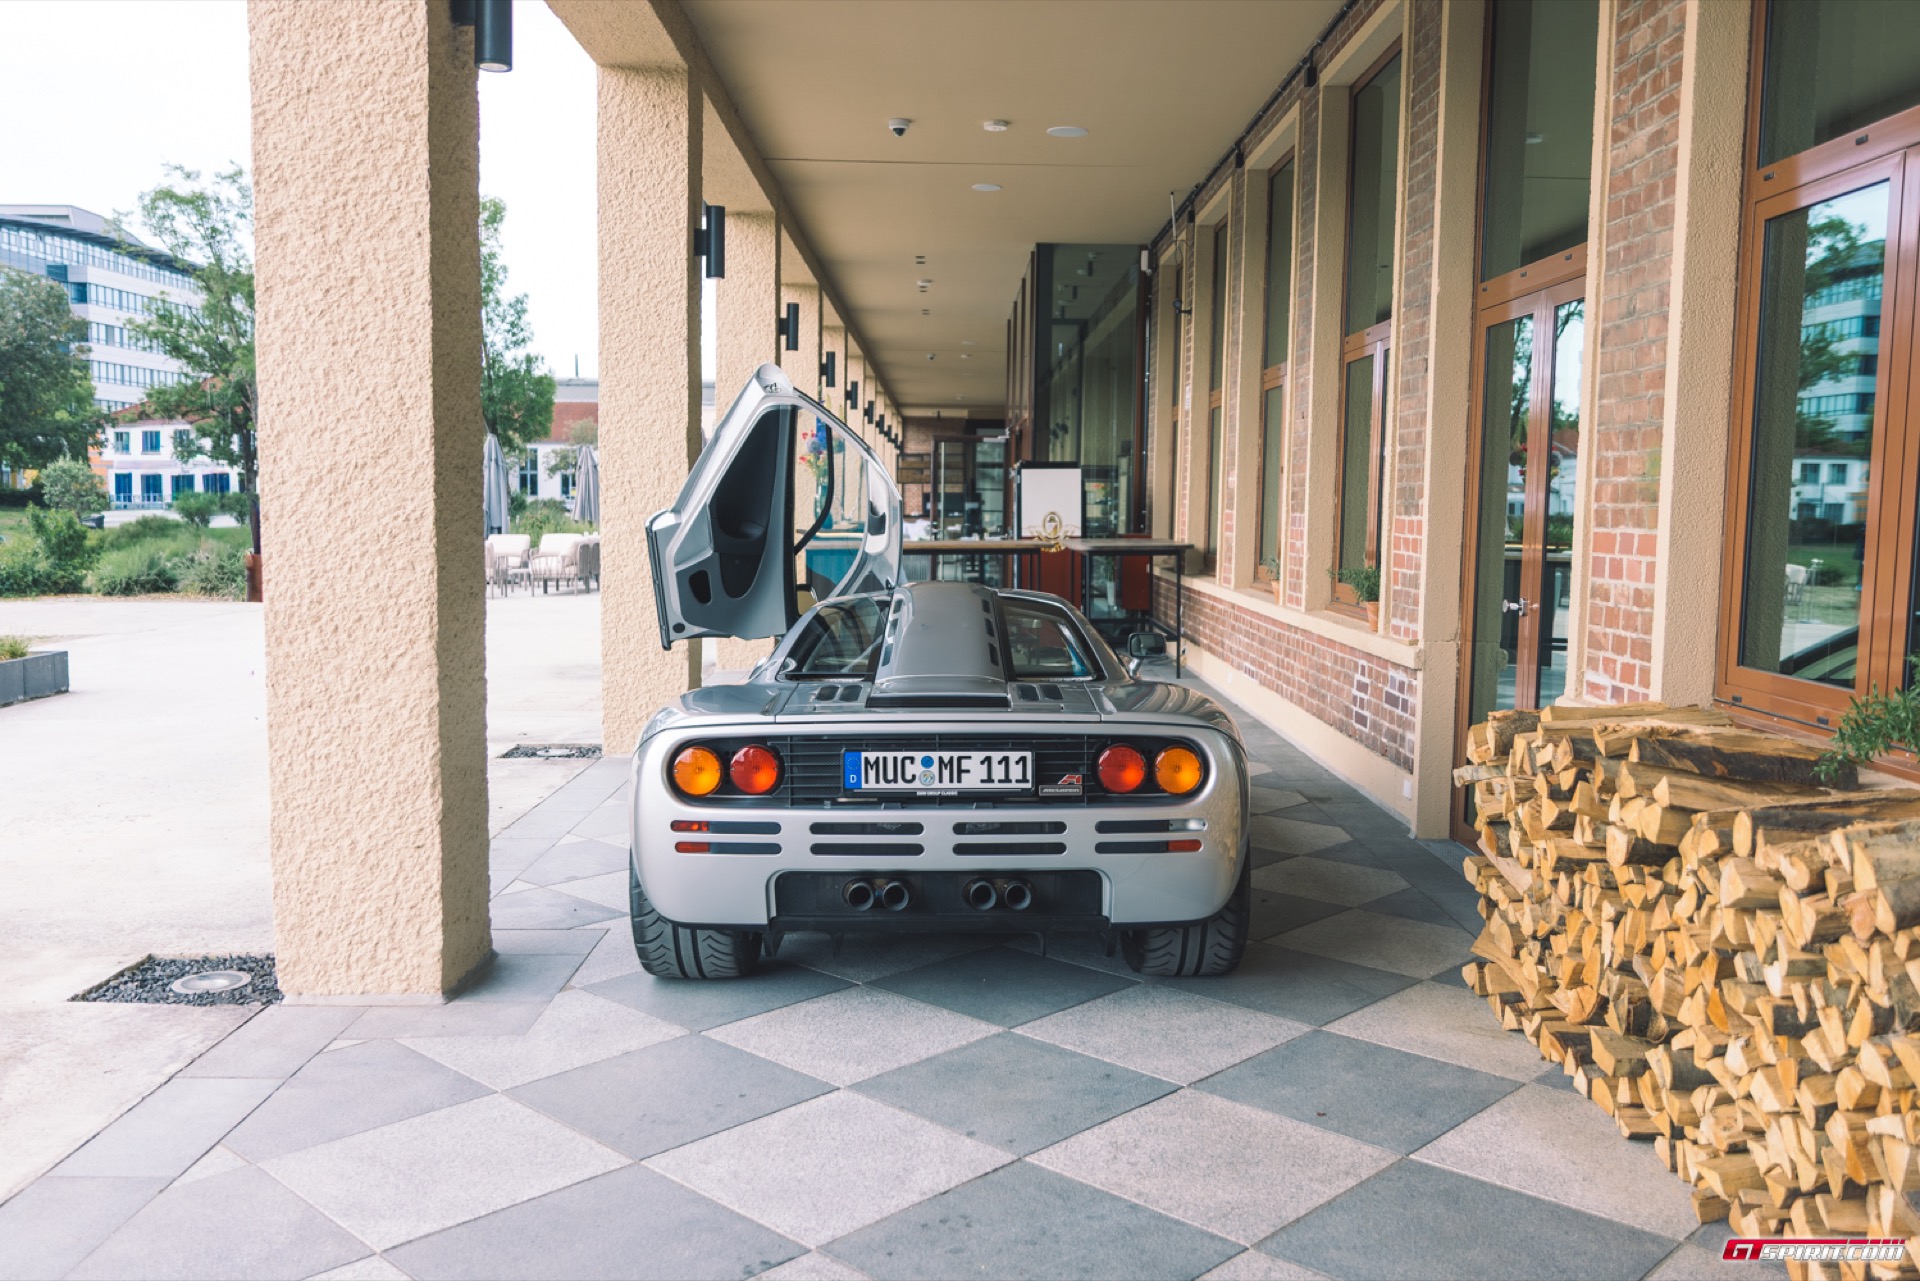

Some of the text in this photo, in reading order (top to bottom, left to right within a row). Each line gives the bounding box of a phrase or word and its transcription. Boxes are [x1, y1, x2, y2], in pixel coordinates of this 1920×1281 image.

[849, 774, 858, 784] D
[863, 755, 1031, 785] MUC MF 111
